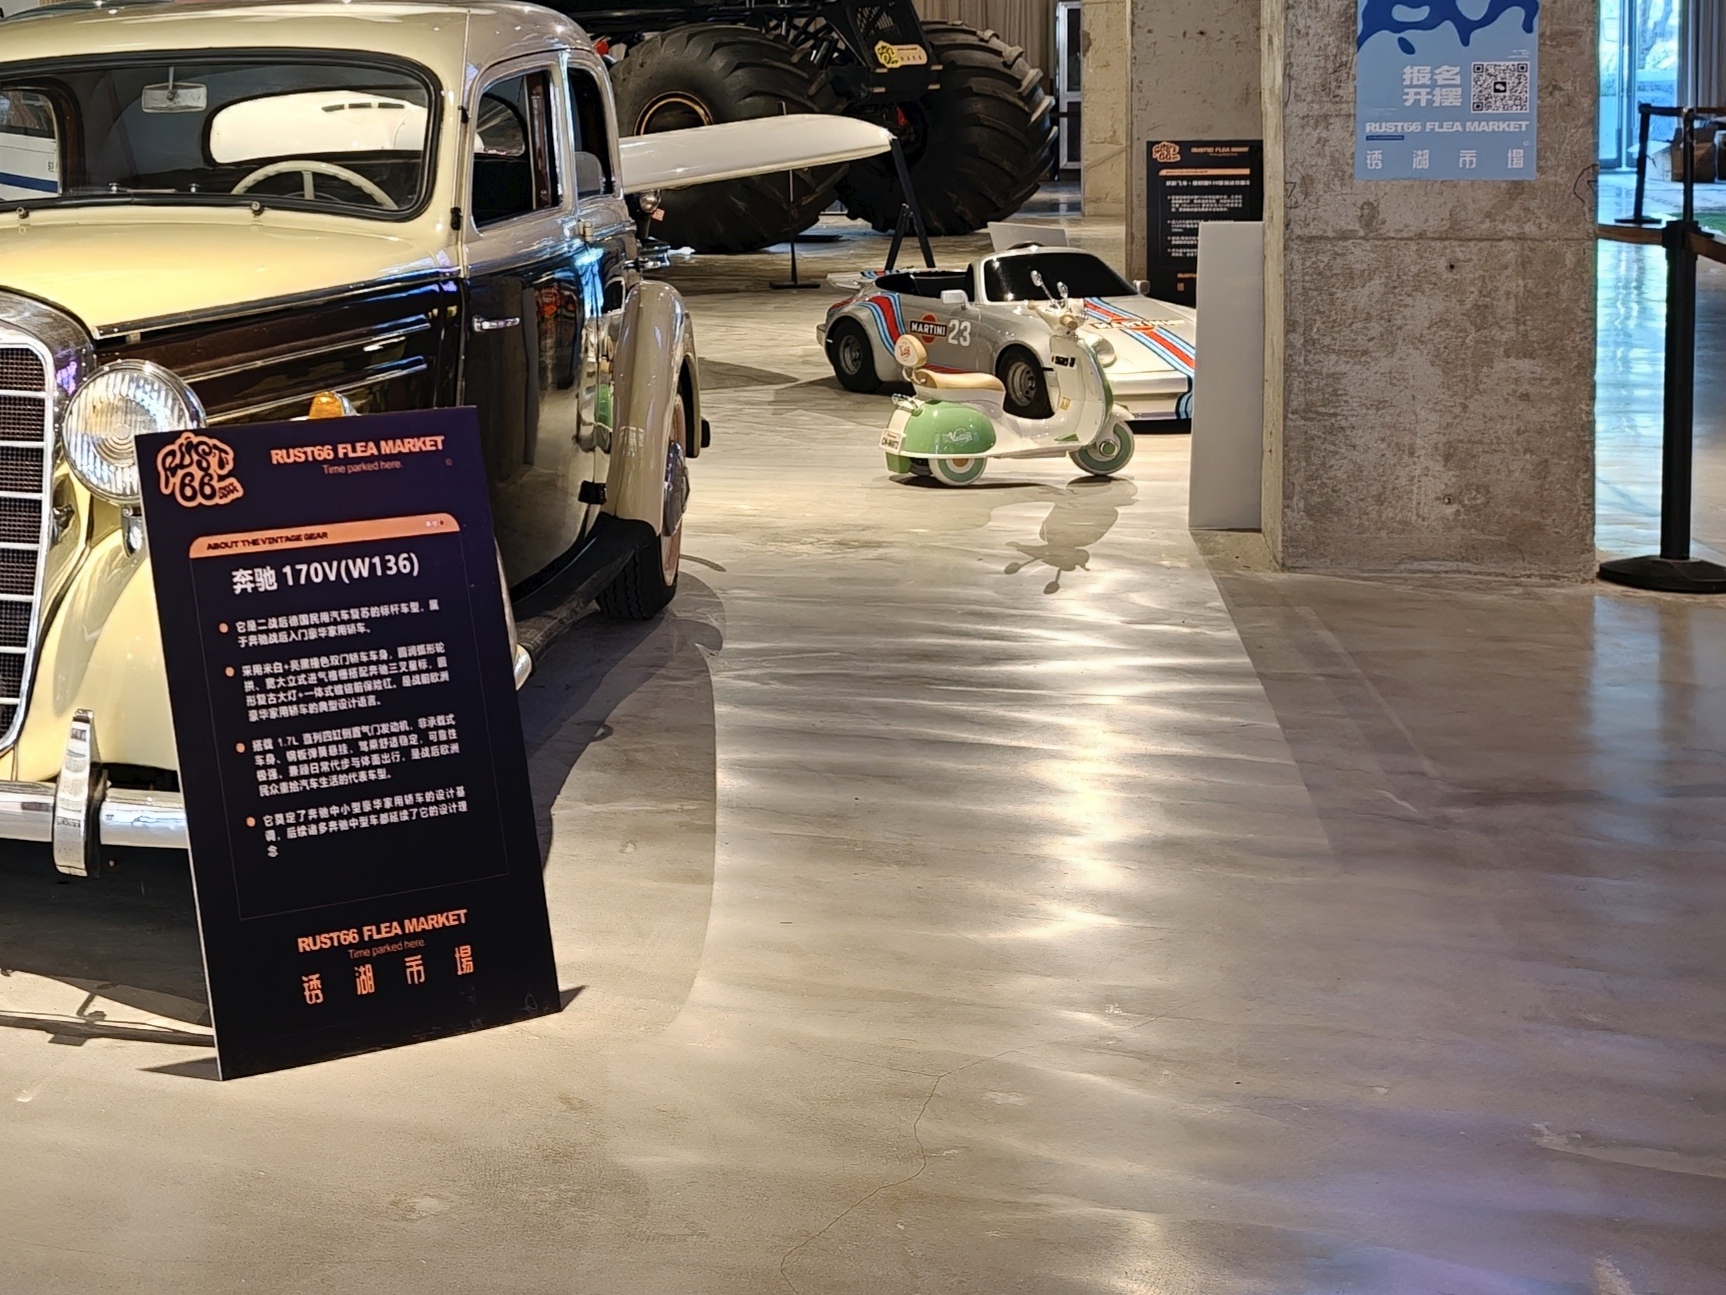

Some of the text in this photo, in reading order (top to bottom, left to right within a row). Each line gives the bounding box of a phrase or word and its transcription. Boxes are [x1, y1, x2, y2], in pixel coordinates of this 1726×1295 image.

[1402, 65, 1461, 85] 报名
[1402, 87, 1462, 107] 开摆
[1366, 120, 1530, 133] RUST66 FLEA MARKET
[911, 319, 971, 346] MARTINI 23
[270, 435, 445, 465] RUST66 FLEA MARKET
[322, 463, 346, 475] Time
[348, 461, 379, 474] parked
[179, 471, 217, 503] 66
[206, 540, 240, 551] ABOUT
[261, 534, 302, 546] VINTAGE
[231, 550, 420, 594] 奔驰 170V(W136)
[277, 735, 299, 747] 1.7L
[266, 844, 278, 858] 念
[297, 909, 468, 952] RUST66 FLEA MARKET
[348, 947, 371, 960] Time
[372, 941, 403, 957] parked
